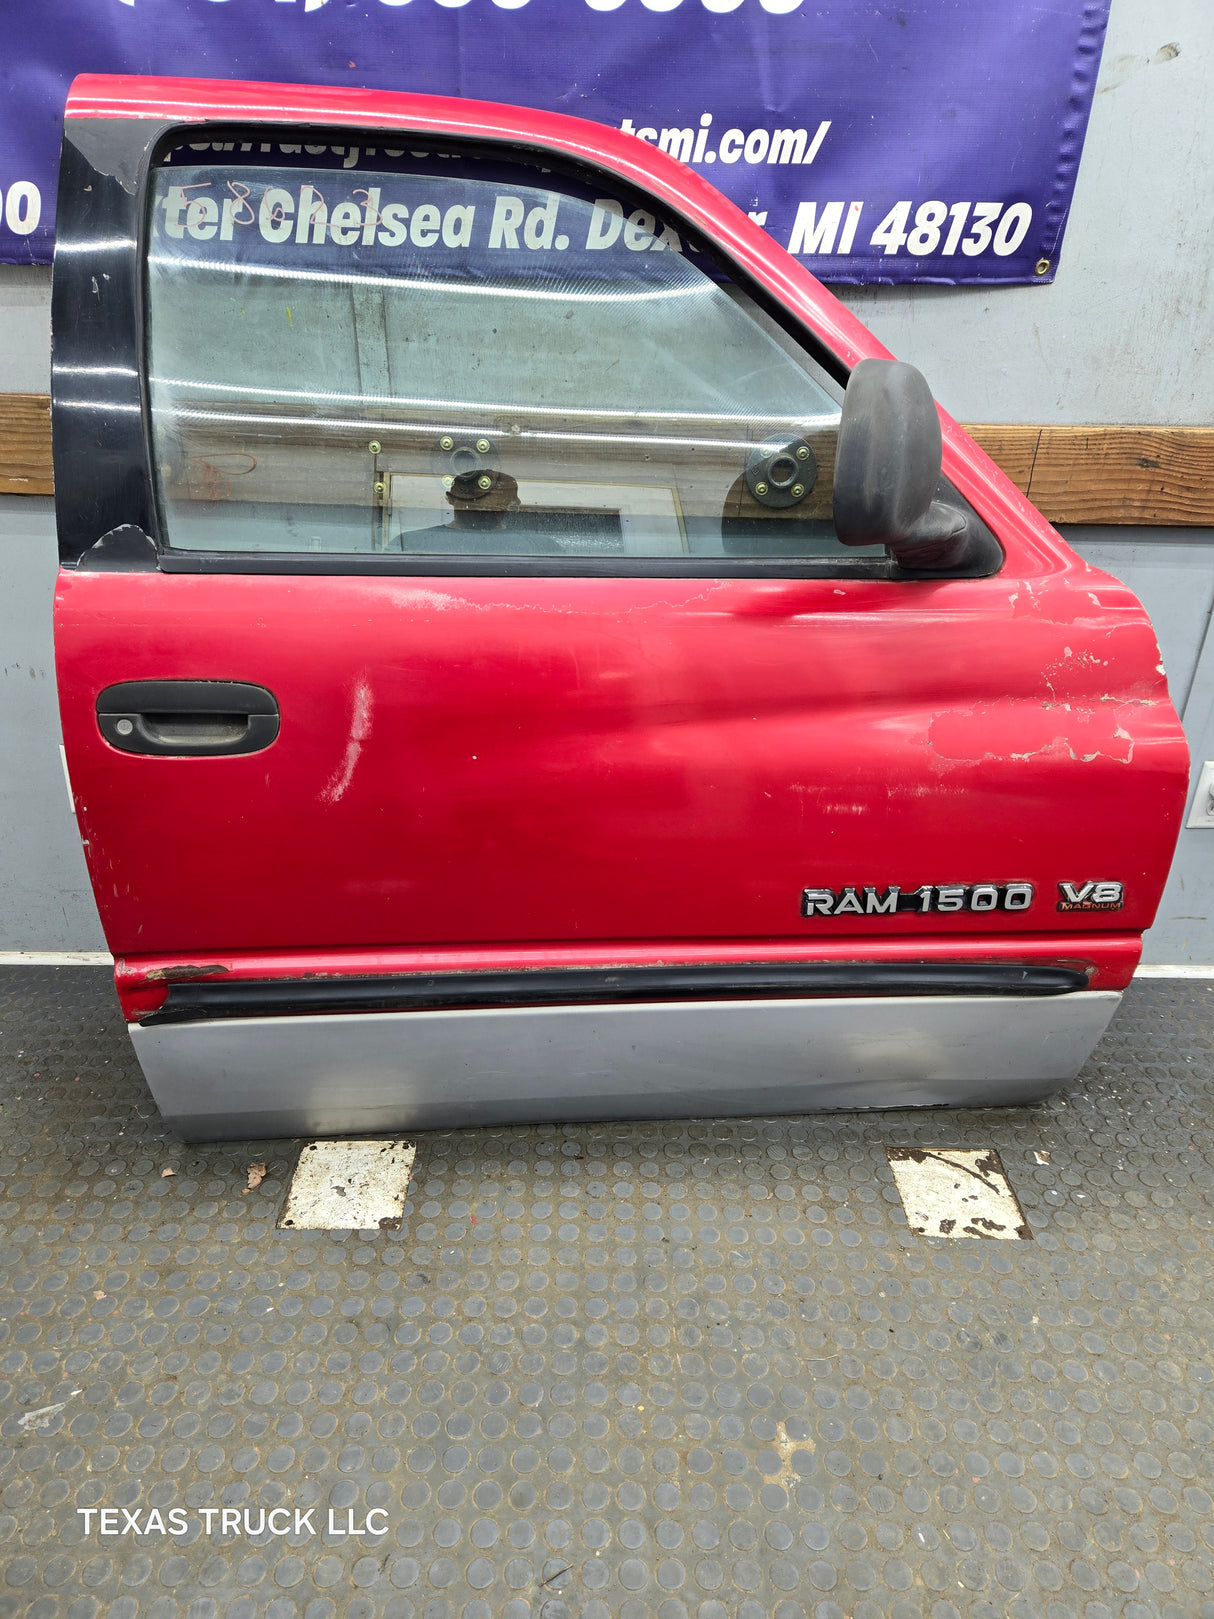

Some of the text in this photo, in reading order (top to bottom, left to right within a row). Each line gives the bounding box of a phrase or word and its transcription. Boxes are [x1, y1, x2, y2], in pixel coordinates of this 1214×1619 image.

[0, 180, 42, 235] 0
[258, 185, 476, 247] Chelsea
[487, 194, 570, 250] Rd.
[787, 201, 864, 255] MI
[869, 200, 1033, 257] 48130
[803, 883, 1034, 916] RAM 1500
[1059, 881, 1123, 903] V8
[1061, 902, 1121, 911] MAGNUM
